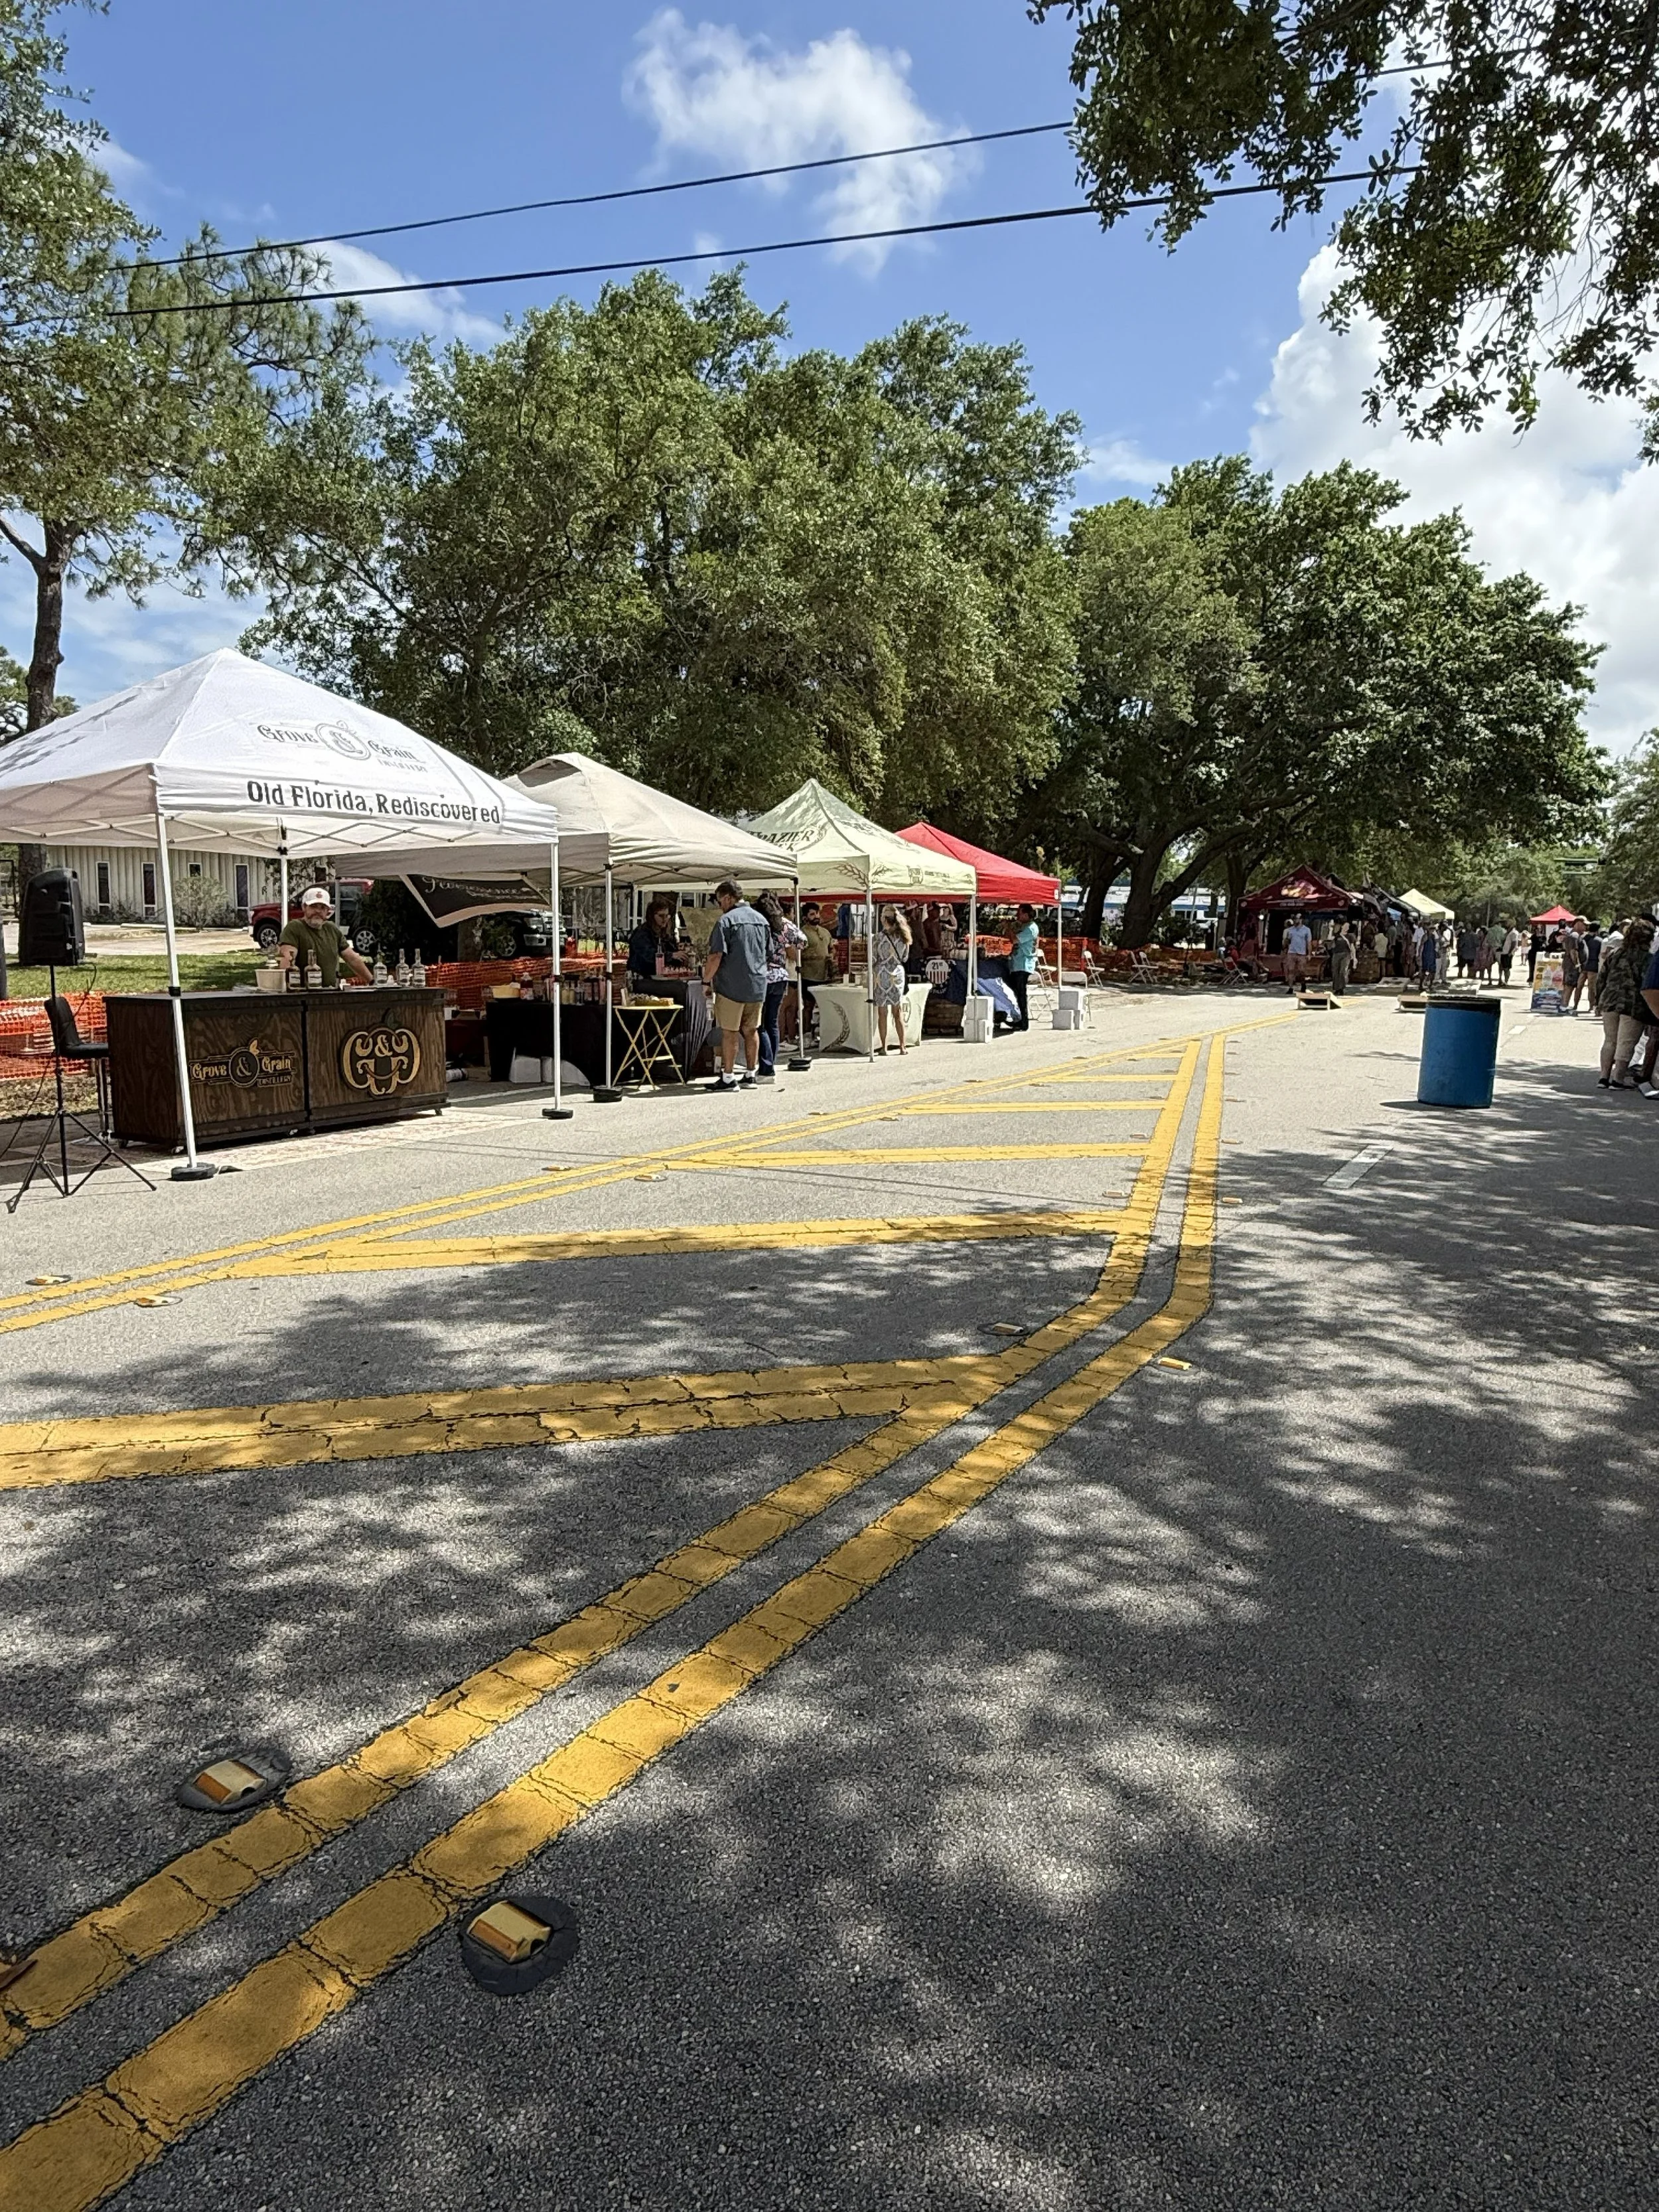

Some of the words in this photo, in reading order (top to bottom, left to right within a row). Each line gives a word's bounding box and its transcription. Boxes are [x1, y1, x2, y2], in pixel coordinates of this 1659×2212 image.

[257, 724, 319, 744] Grove
[368, 740, 419, 761] Grain
[247, 780, 285, 806] Old
[291, 784, 373, 815] Florida,
[376, 794, 500, 824] Rediscovered
[192, 1063, 227, 1080] Grove
[236, 1057, 252, 1077] &
[261, 1056, 292, 1072] Grain
